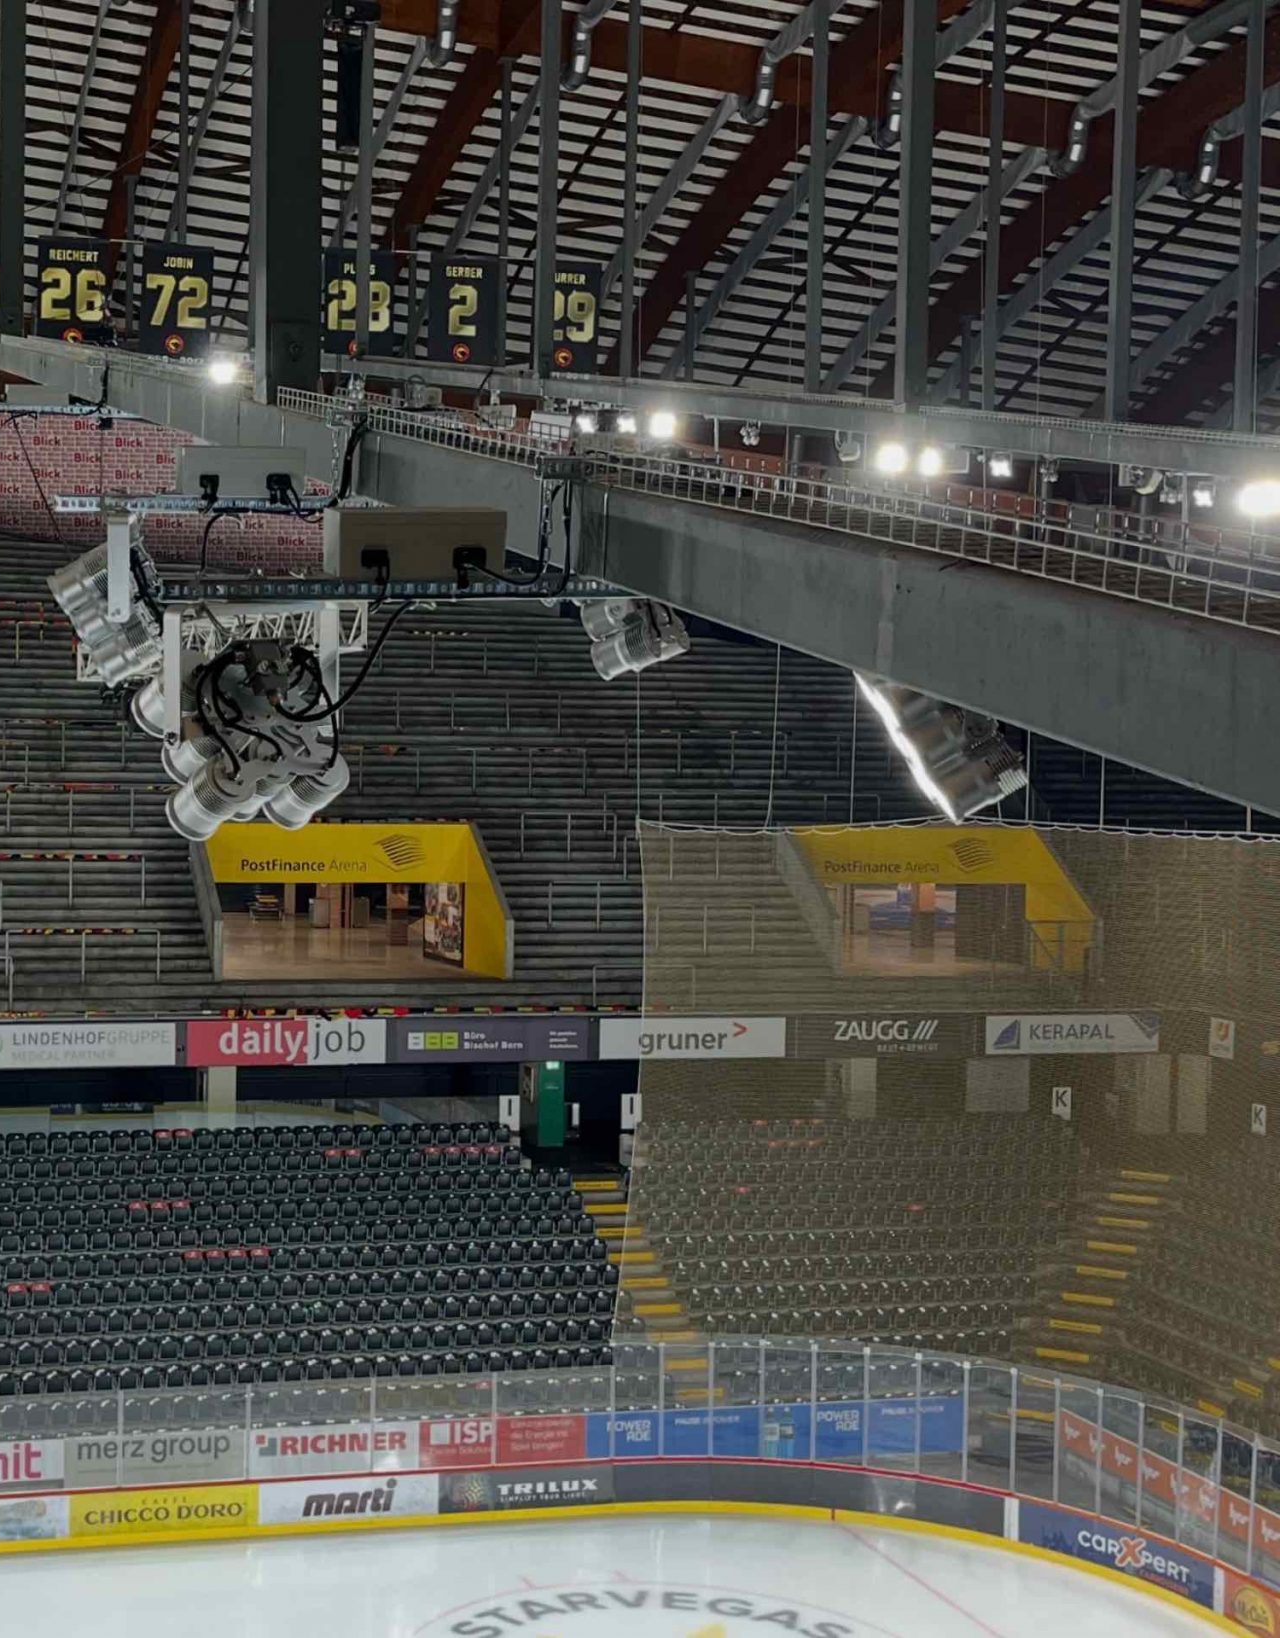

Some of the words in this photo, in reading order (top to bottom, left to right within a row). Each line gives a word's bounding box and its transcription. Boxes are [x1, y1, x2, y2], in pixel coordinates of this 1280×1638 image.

[49, 249, 99, 262] REICHERT
[164, 256, 193, 269] JOBIN
[344, 262, 376, 275] PLS
[446, 265, 483, 279] GERBER
[554, 272, 586, 285] URRER
[40, 267, 106, 322] 26
[146, 273, 209, 329] 72
[327, 279, 391, 332] 28
[448, 283, 478, 337] 2
[74, 420, 101, 431] Blic
[33, 436, 61, 447] Blick
[115, 437, 143, 449] Blick
[74, 453, 102, 464] Blick
[156, 454, 177, 465] Blic
[115, 470, 143, 481] Blick
[156, 518, 184, 530] Blick
[241, 859, 325, 872] PostFinance
[329, 860, 367, 872] Arena
[825, 861, 901, 874] PostFinance
[904, 862, 939, 874] Arena
[12, 1030, 170, 1046] LINDENHOFGRUPPE
[834, 1020, 908, 1041] ZAUGG
[1029, 1024, 1115, 1040] KERAPAL
[639, 1030, 728, 1056] gruner
[1055, 1090, 1067, 1107] K
[1253, 1106, 1263, 1125] K
[817, 1410, 860, 1422] POWER
[454, 1421, 493, 1444] ISP
[77, 1440, 145, 1460] merz
[151, 1434, 232, 1463] group
[280, 1431, 407, 1456] RICHNER
[497, 1478, 598, 1495] TRILUX
[302, 1478, 397, 1517] marti
[84, 1504, 170, 1525] CHICCO
[177, 1503, 243, 1521] D'ORO
[451, 1591, 854, 1638] STARVEGAS
